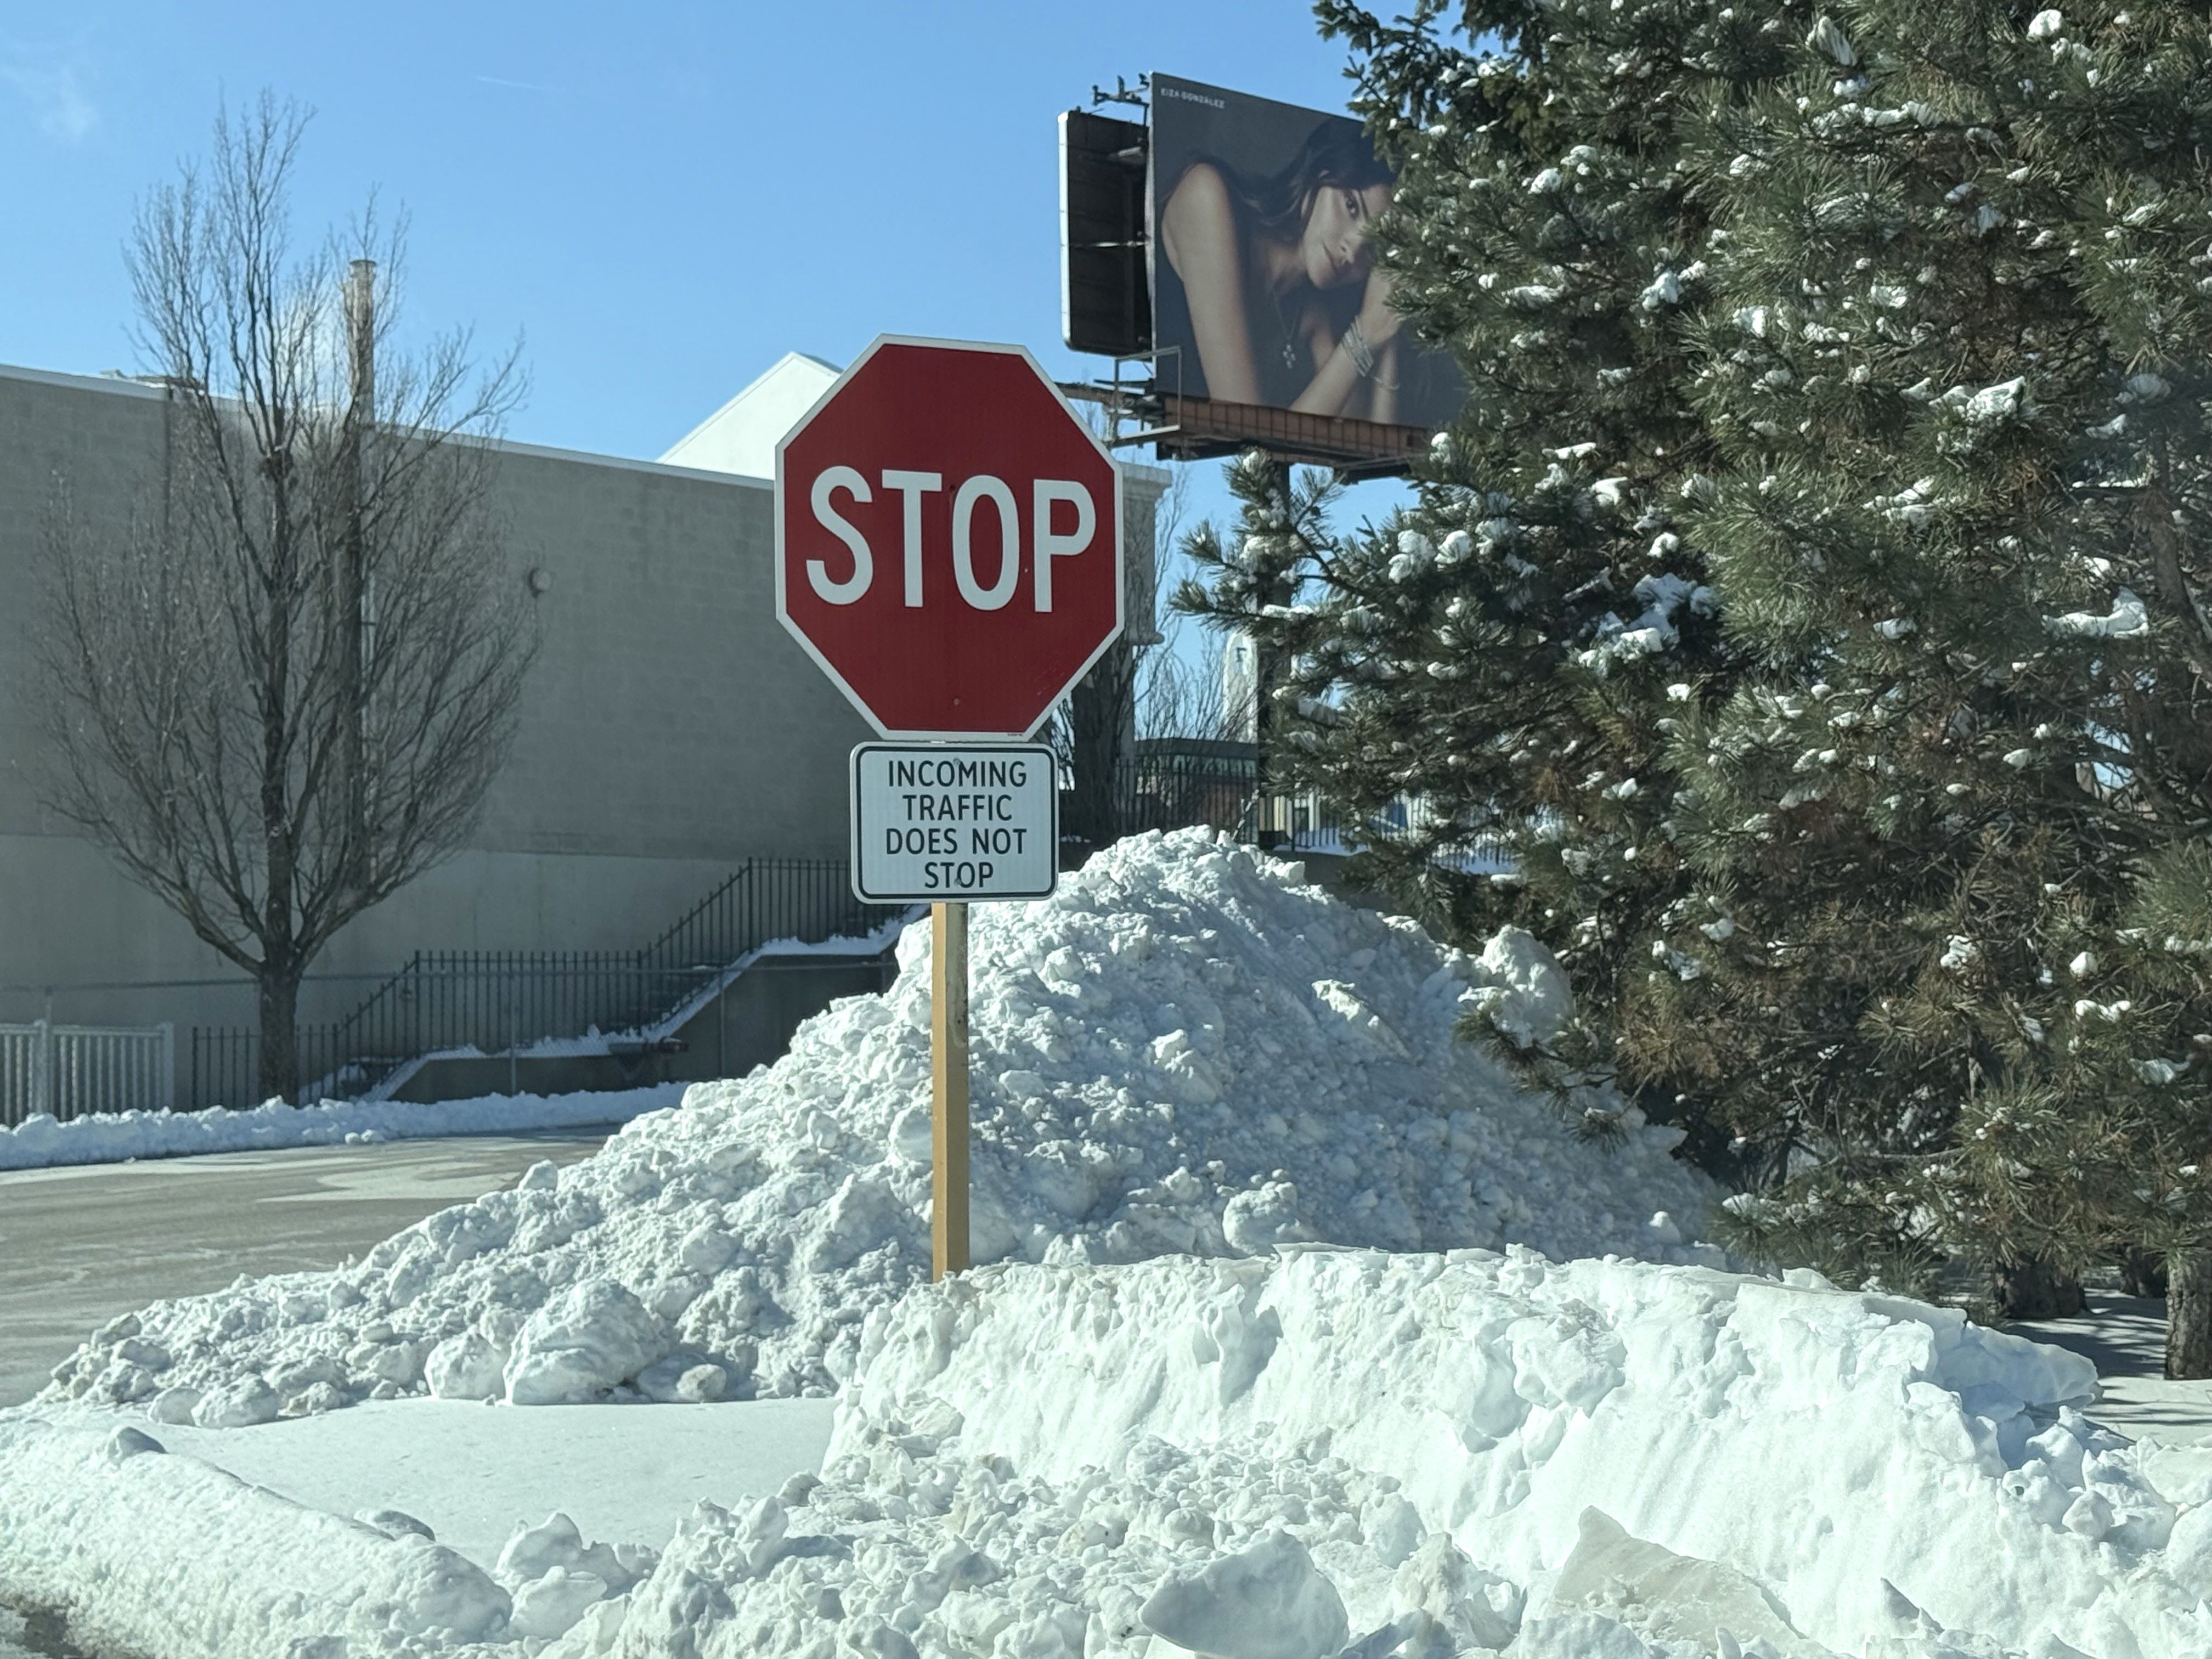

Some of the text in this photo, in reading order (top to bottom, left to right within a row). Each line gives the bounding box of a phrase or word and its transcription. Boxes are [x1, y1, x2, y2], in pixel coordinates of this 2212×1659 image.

[806, 465, 1096, 613] STOP
[888, 760, 1027, 787] INCOMING
[902, 794, 1012, 821] TRAFFIC
[886, 828, 1027, 854] DOES NOT
[924, 862, 994, 888] STOP
